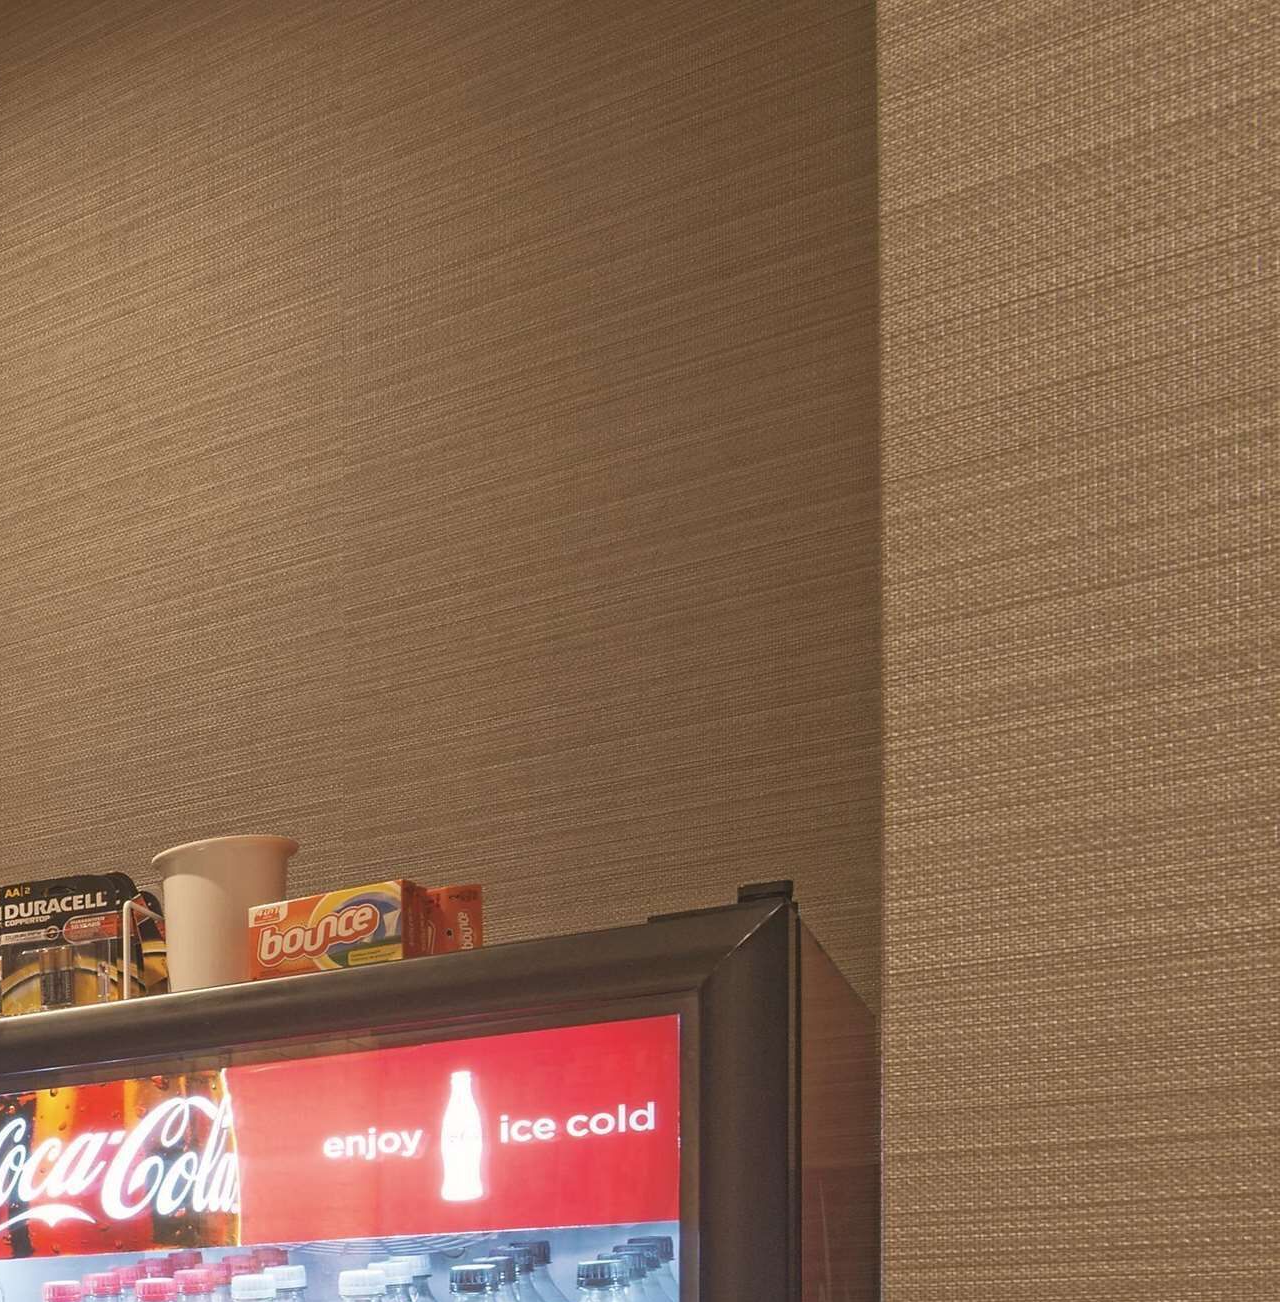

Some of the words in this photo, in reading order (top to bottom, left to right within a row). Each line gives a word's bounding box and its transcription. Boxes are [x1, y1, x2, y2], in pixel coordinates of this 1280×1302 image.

[4, 889, 20, 898] AA
[4, 891, 107, 920] DURACELL
[5, 915, 50, 927] COPPERTOP
[261, 906, 374, 961] bounce
[458, 912, 474, 950] bounce
[322, 1127, 422, 1163] enjoy
[499, 1114, 555, 1144] ice
[566, 1102, 656, 1138] cold
